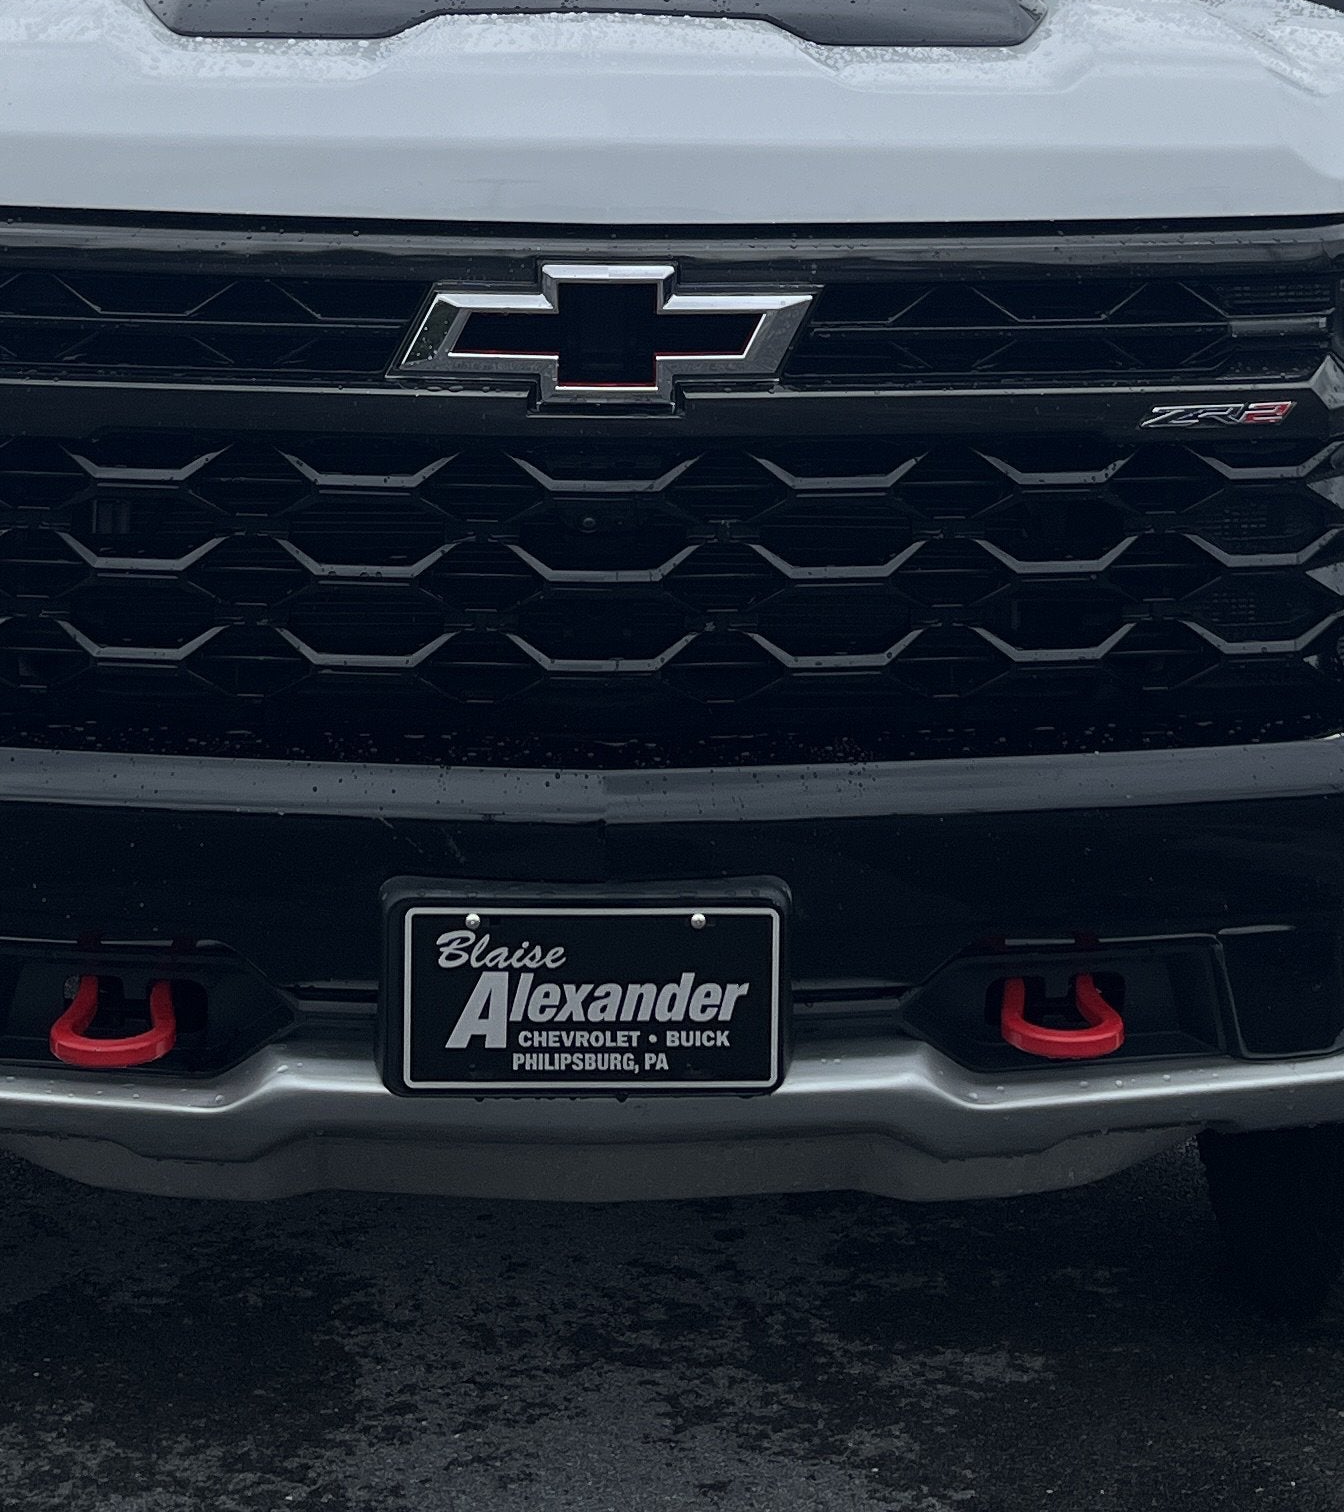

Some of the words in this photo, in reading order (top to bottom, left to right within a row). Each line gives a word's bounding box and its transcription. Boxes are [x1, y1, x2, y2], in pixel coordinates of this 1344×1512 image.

[1139, 400, 1298, 428] ZR2
[436, 930, 566, 968] Blaise
[445, 971, 750, 1049] Alexander
[518, 1030, 641, 1048] CHEVROLET
[666, 1030, 730, 1048] BUICK
[512, 1053, 640, 1074] PHILIPSBURG,
[644, 1053, 669, 1071] PA
